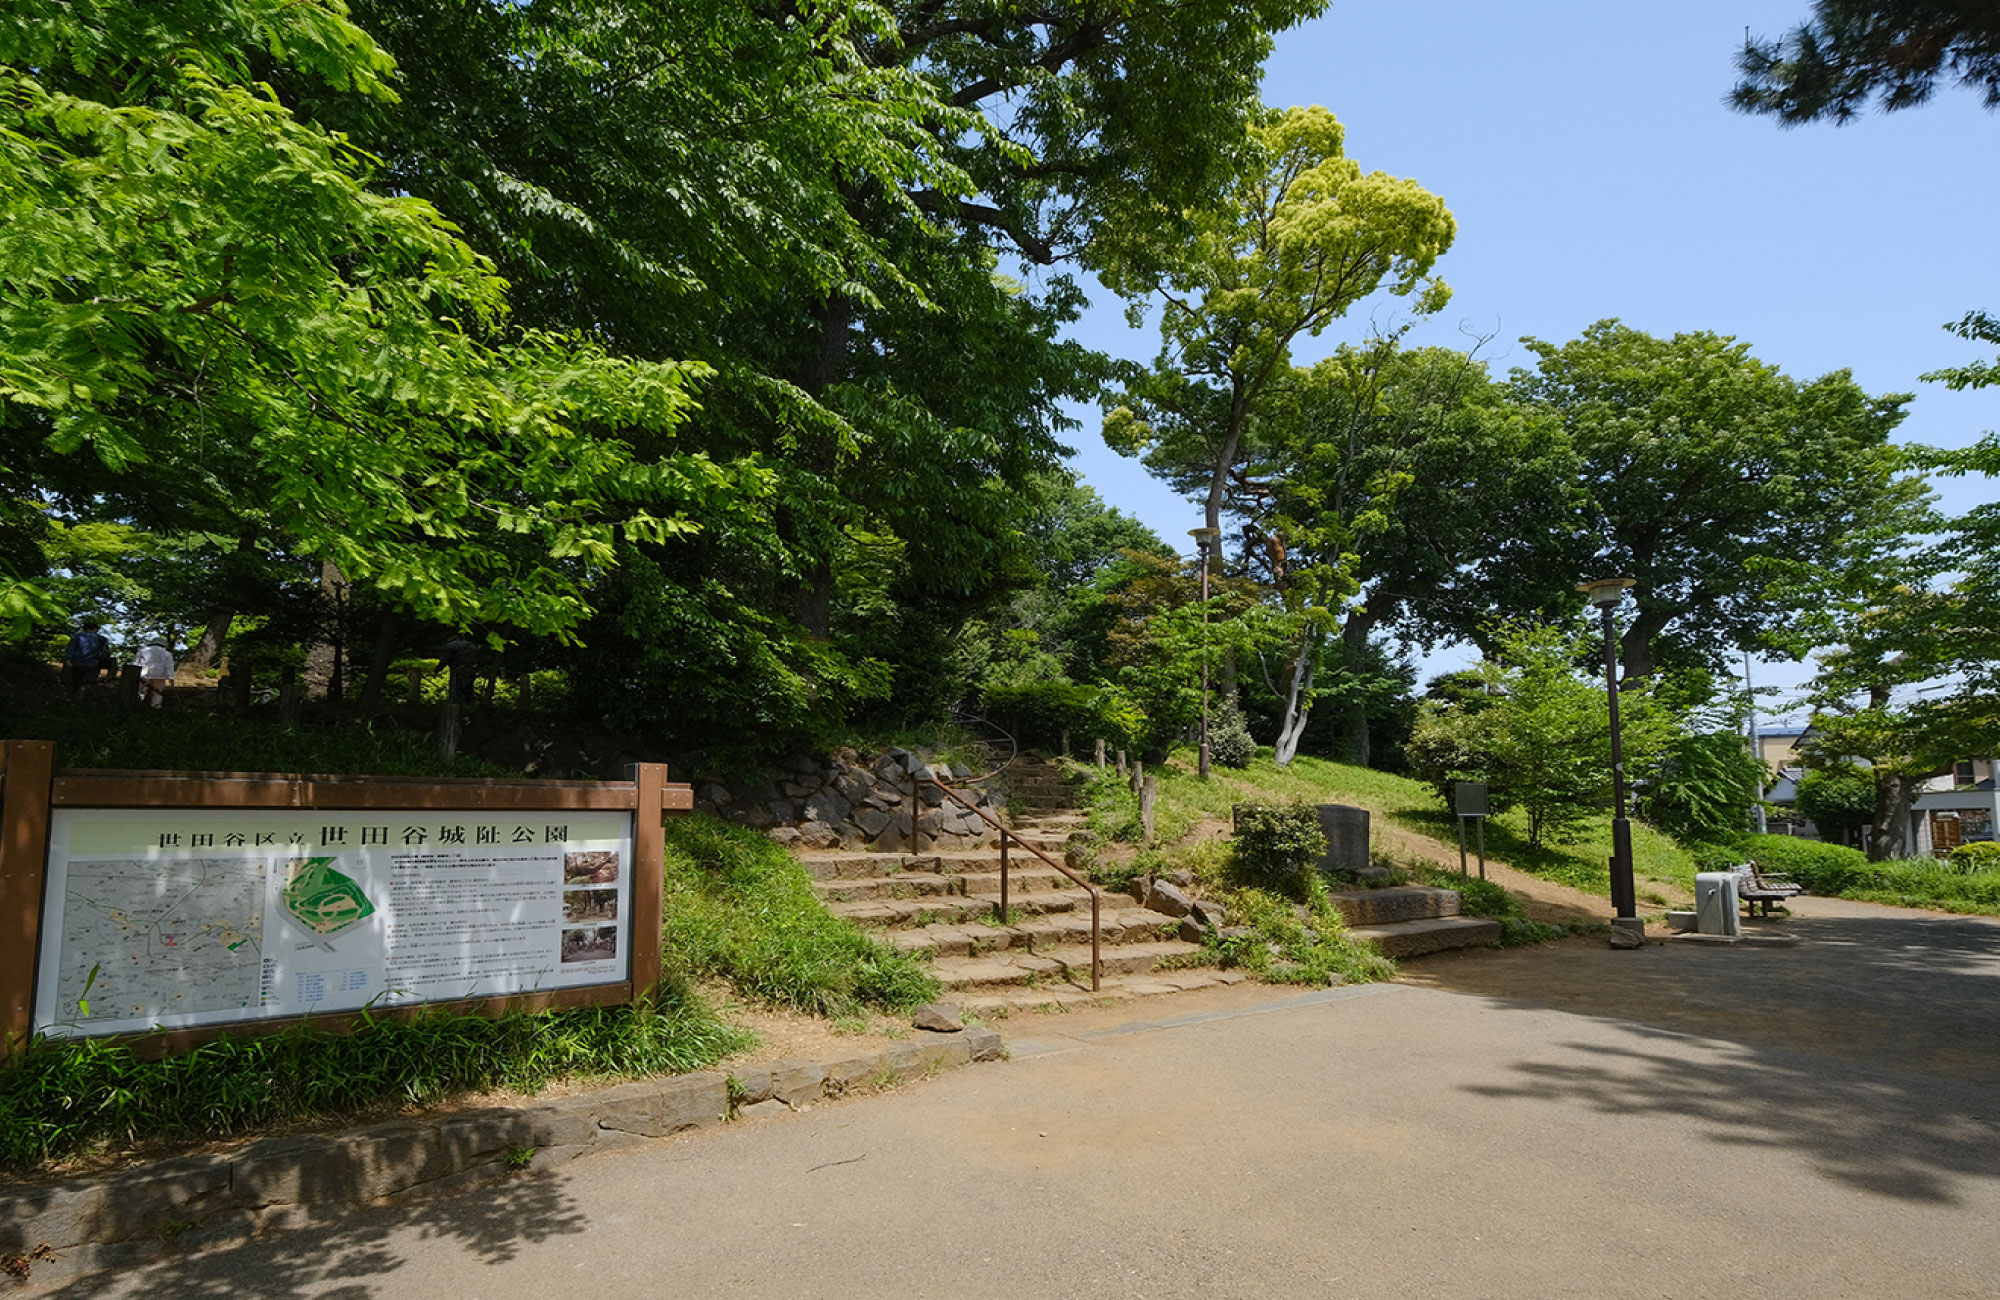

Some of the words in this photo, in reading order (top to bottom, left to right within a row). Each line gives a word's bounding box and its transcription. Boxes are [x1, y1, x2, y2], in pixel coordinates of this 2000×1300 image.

[158, 831, 306, 848] 世田谷区立
